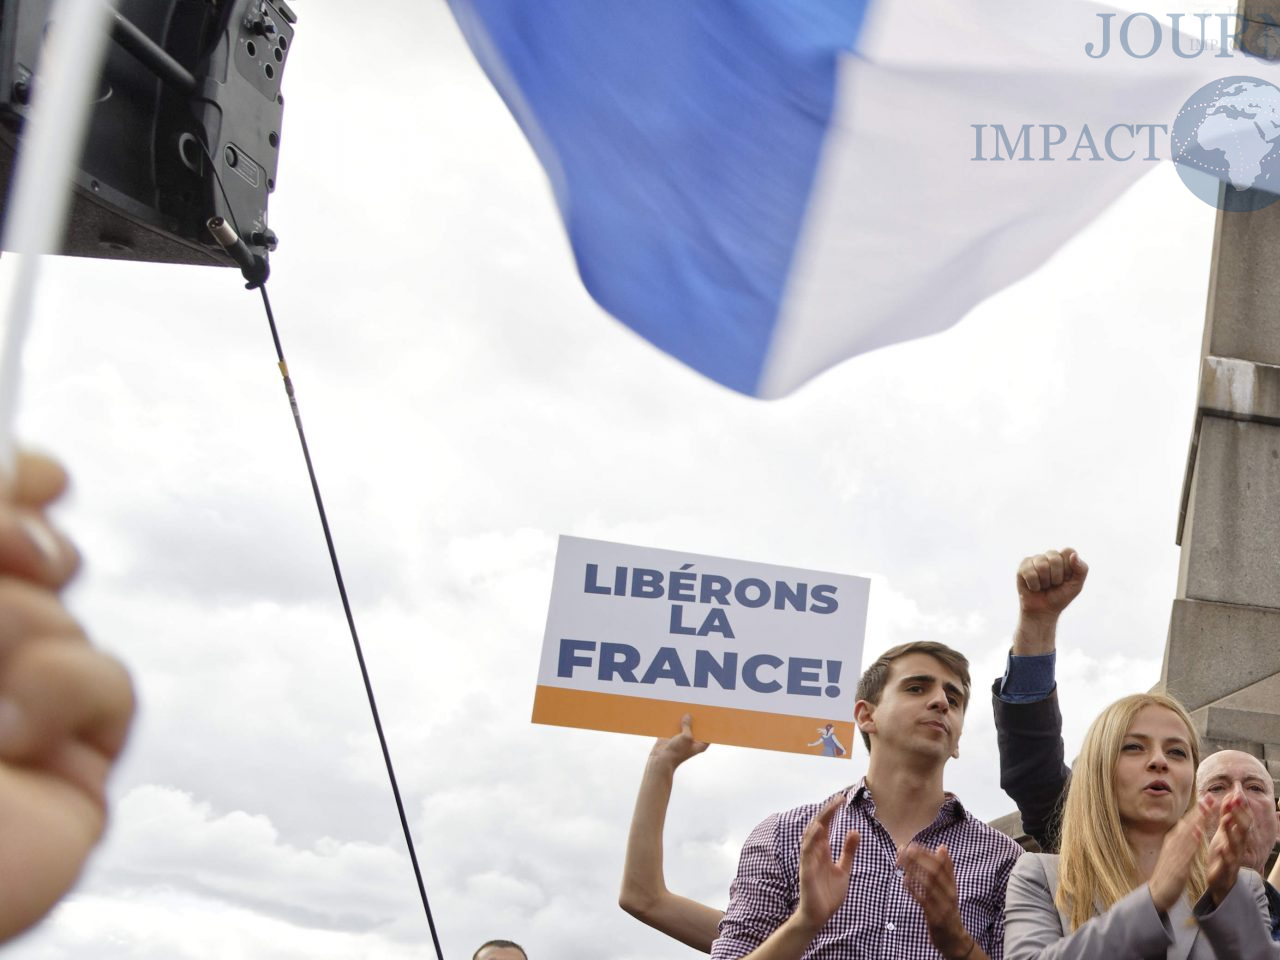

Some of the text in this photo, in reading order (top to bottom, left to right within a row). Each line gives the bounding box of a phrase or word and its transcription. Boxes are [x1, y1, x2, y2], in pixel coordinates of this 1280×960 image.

[583, 563, 839, 615] LIBÉRONS
[669, 604, 736, 639] LA
[556, 638, 843, 698] FRANCE!
